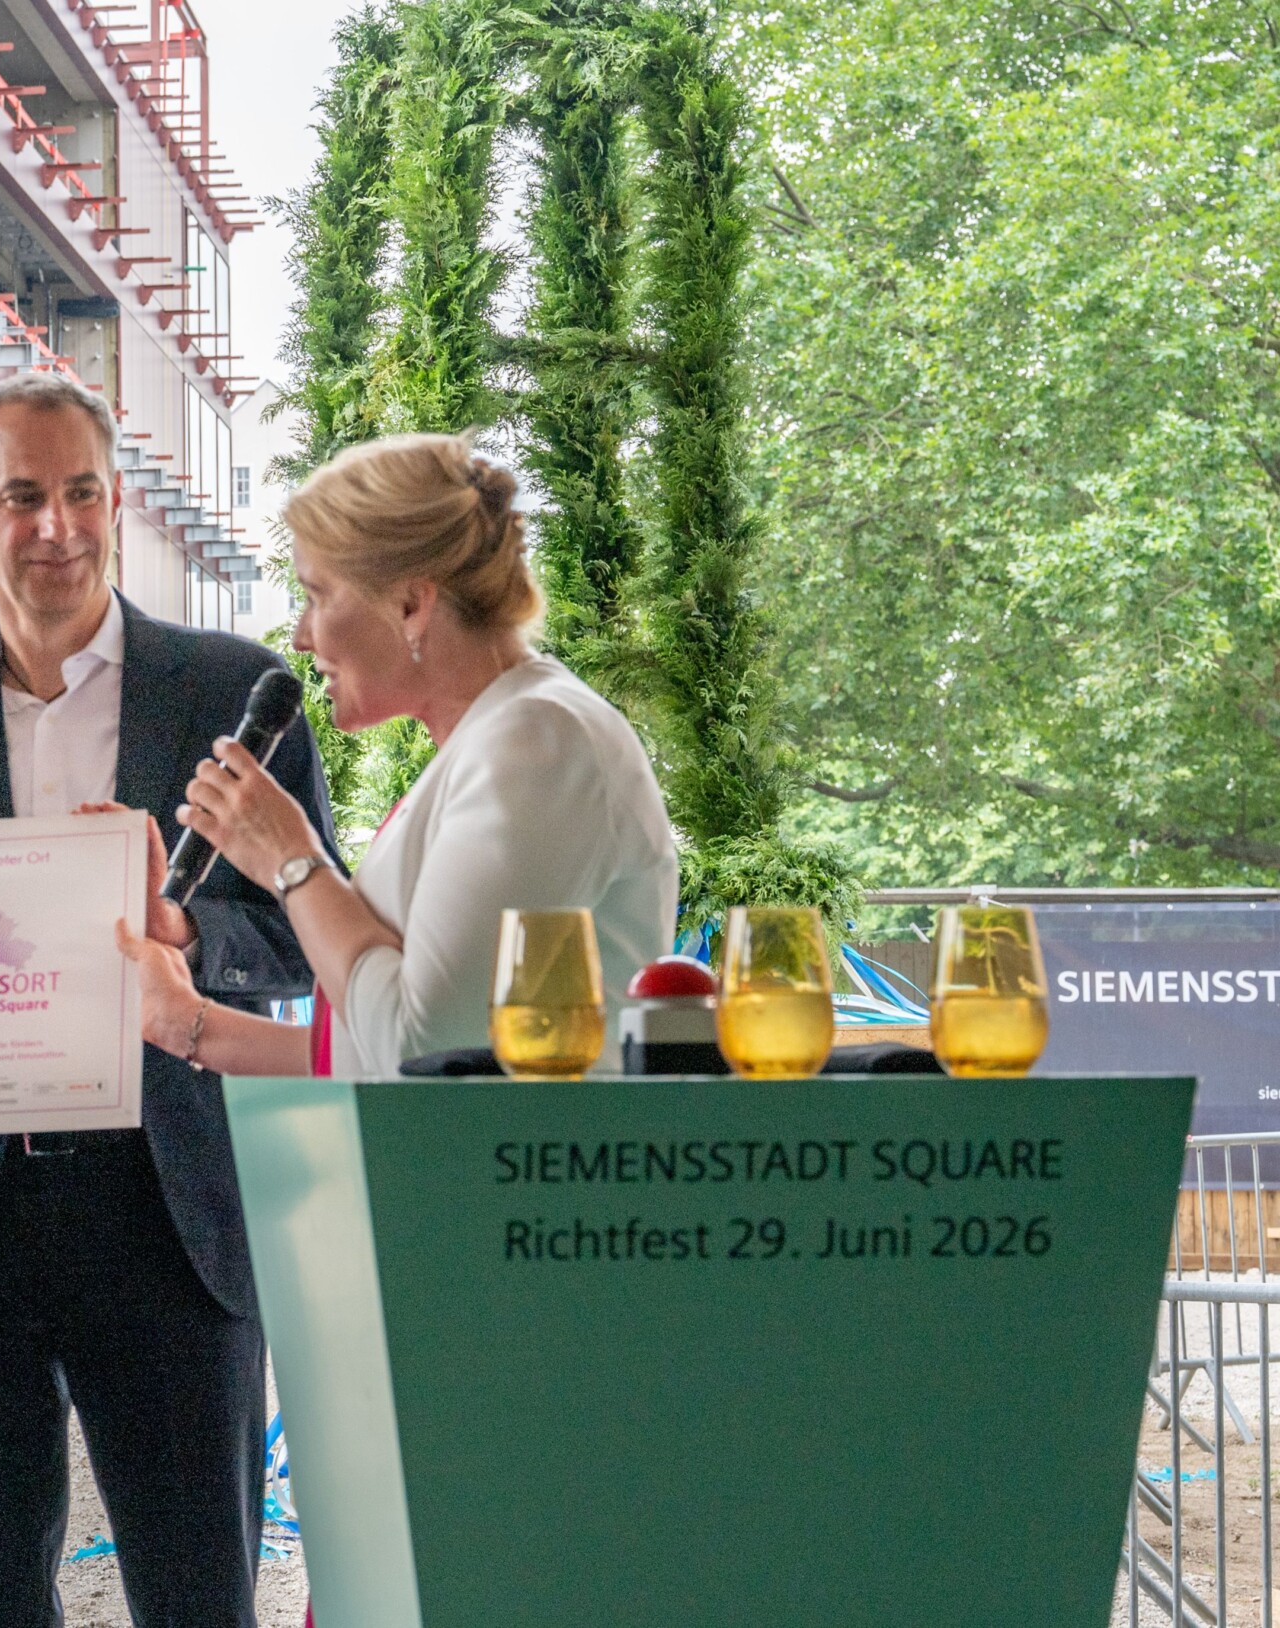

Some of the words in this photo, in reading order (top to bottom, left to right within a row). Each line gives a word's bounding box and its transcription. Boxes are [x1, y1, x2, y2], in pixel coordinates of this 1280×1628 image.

[26, 851, 50, 864] Ort
[1057, 970, 1280, 1003] SIEMENSST
[0, 1000, 49, 1014] Square
[1258, 1085, 1280, 1100] sie
[494, 1140, 858, 1184] SIEMENSSTADT
[872, 1138, 1064, 1187] SQUARE
[504, 1218, 710, 1261] Richtfest
[726, 1216, 801, 1260] 29.
[818, 1214, 914, 1260] Juni
[930, 1214, 1053, 1258] 2026
